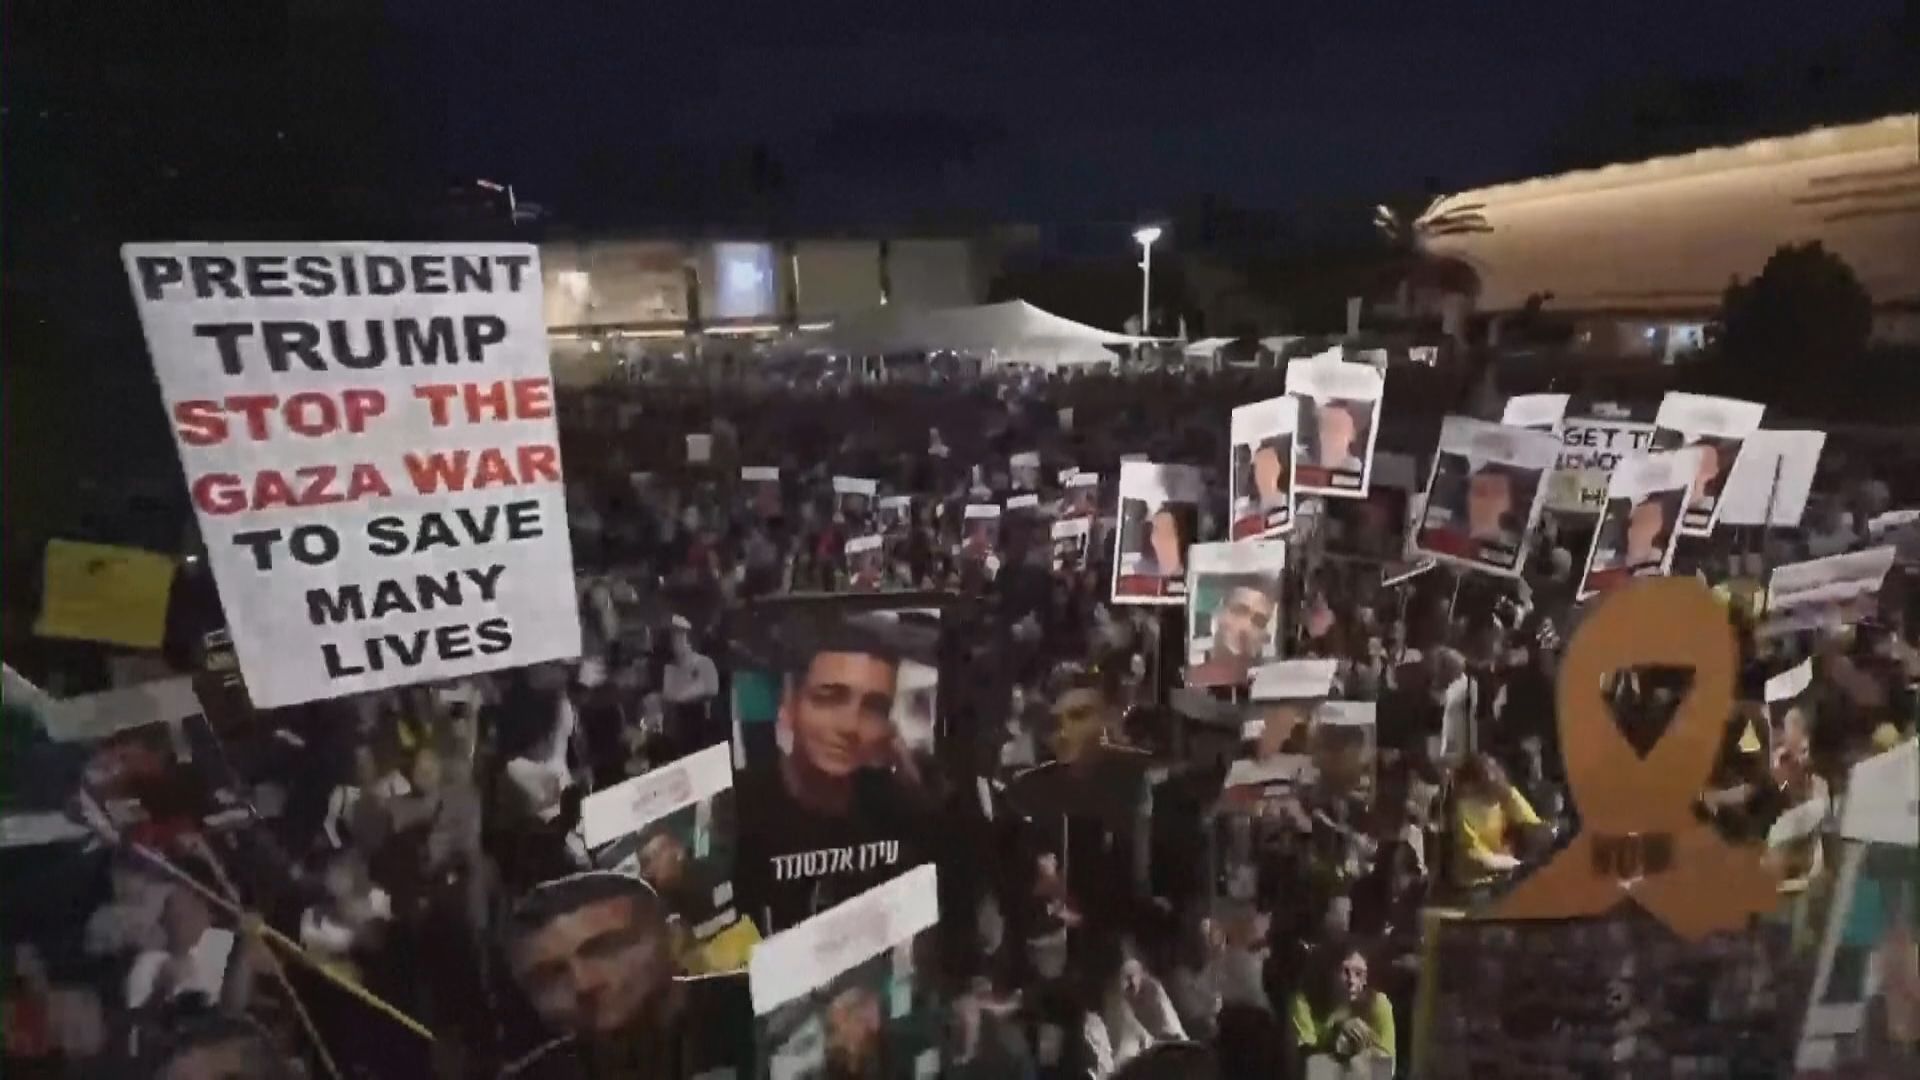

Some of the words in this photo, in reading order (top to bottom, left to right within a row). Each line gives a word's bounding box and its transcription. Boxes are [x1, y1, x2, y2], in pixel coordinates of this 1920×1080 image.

[136, 255, 531, 300] PRESIDENT
[194, 316, 507, 375] TRUMP
[173, 390, 386, 447] STOP
[414, 377, 553, 426] THE
[1563, 426, 1621, 449] GET
[193, 464, 392, 515] GAZA
[404, 445, 560, 494] WAR
[233, 525, 339, 570] TO
[367, 500, 544, 556] SAVE
[306, 564, 505, 625] MANY
[321, 618, 512, 679] LIVES
[769, 845, 853, 880] אלכסנדר
[860, 839, 899, 872] עידן
